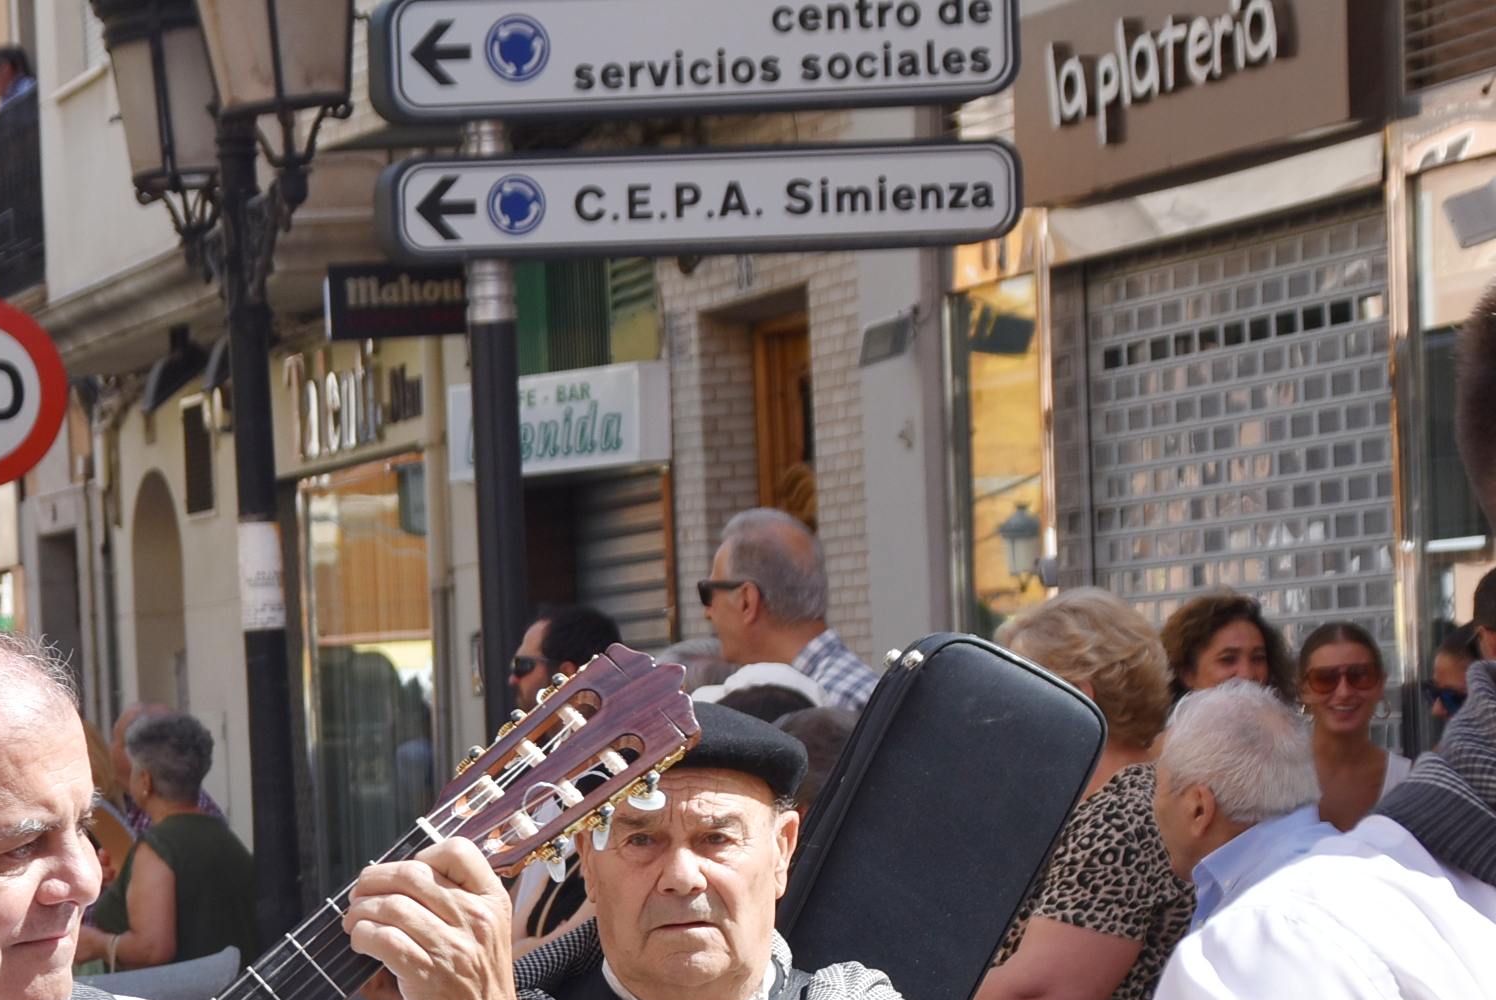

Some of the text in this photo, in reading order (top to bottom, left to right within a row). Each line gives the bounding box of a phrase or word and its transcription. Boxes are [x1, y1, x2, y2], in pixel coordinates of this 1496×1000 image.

[772, 0, 993, 32] centro de
[573, 39, 992, 90] servicios sociales
[1046, 40, 1088, 128] la
[574, 175, 995, 222] C.E.P.A. Simienza
[346, 272, 463, 305] Mahou
[556, 382, 592, 402] BAR
